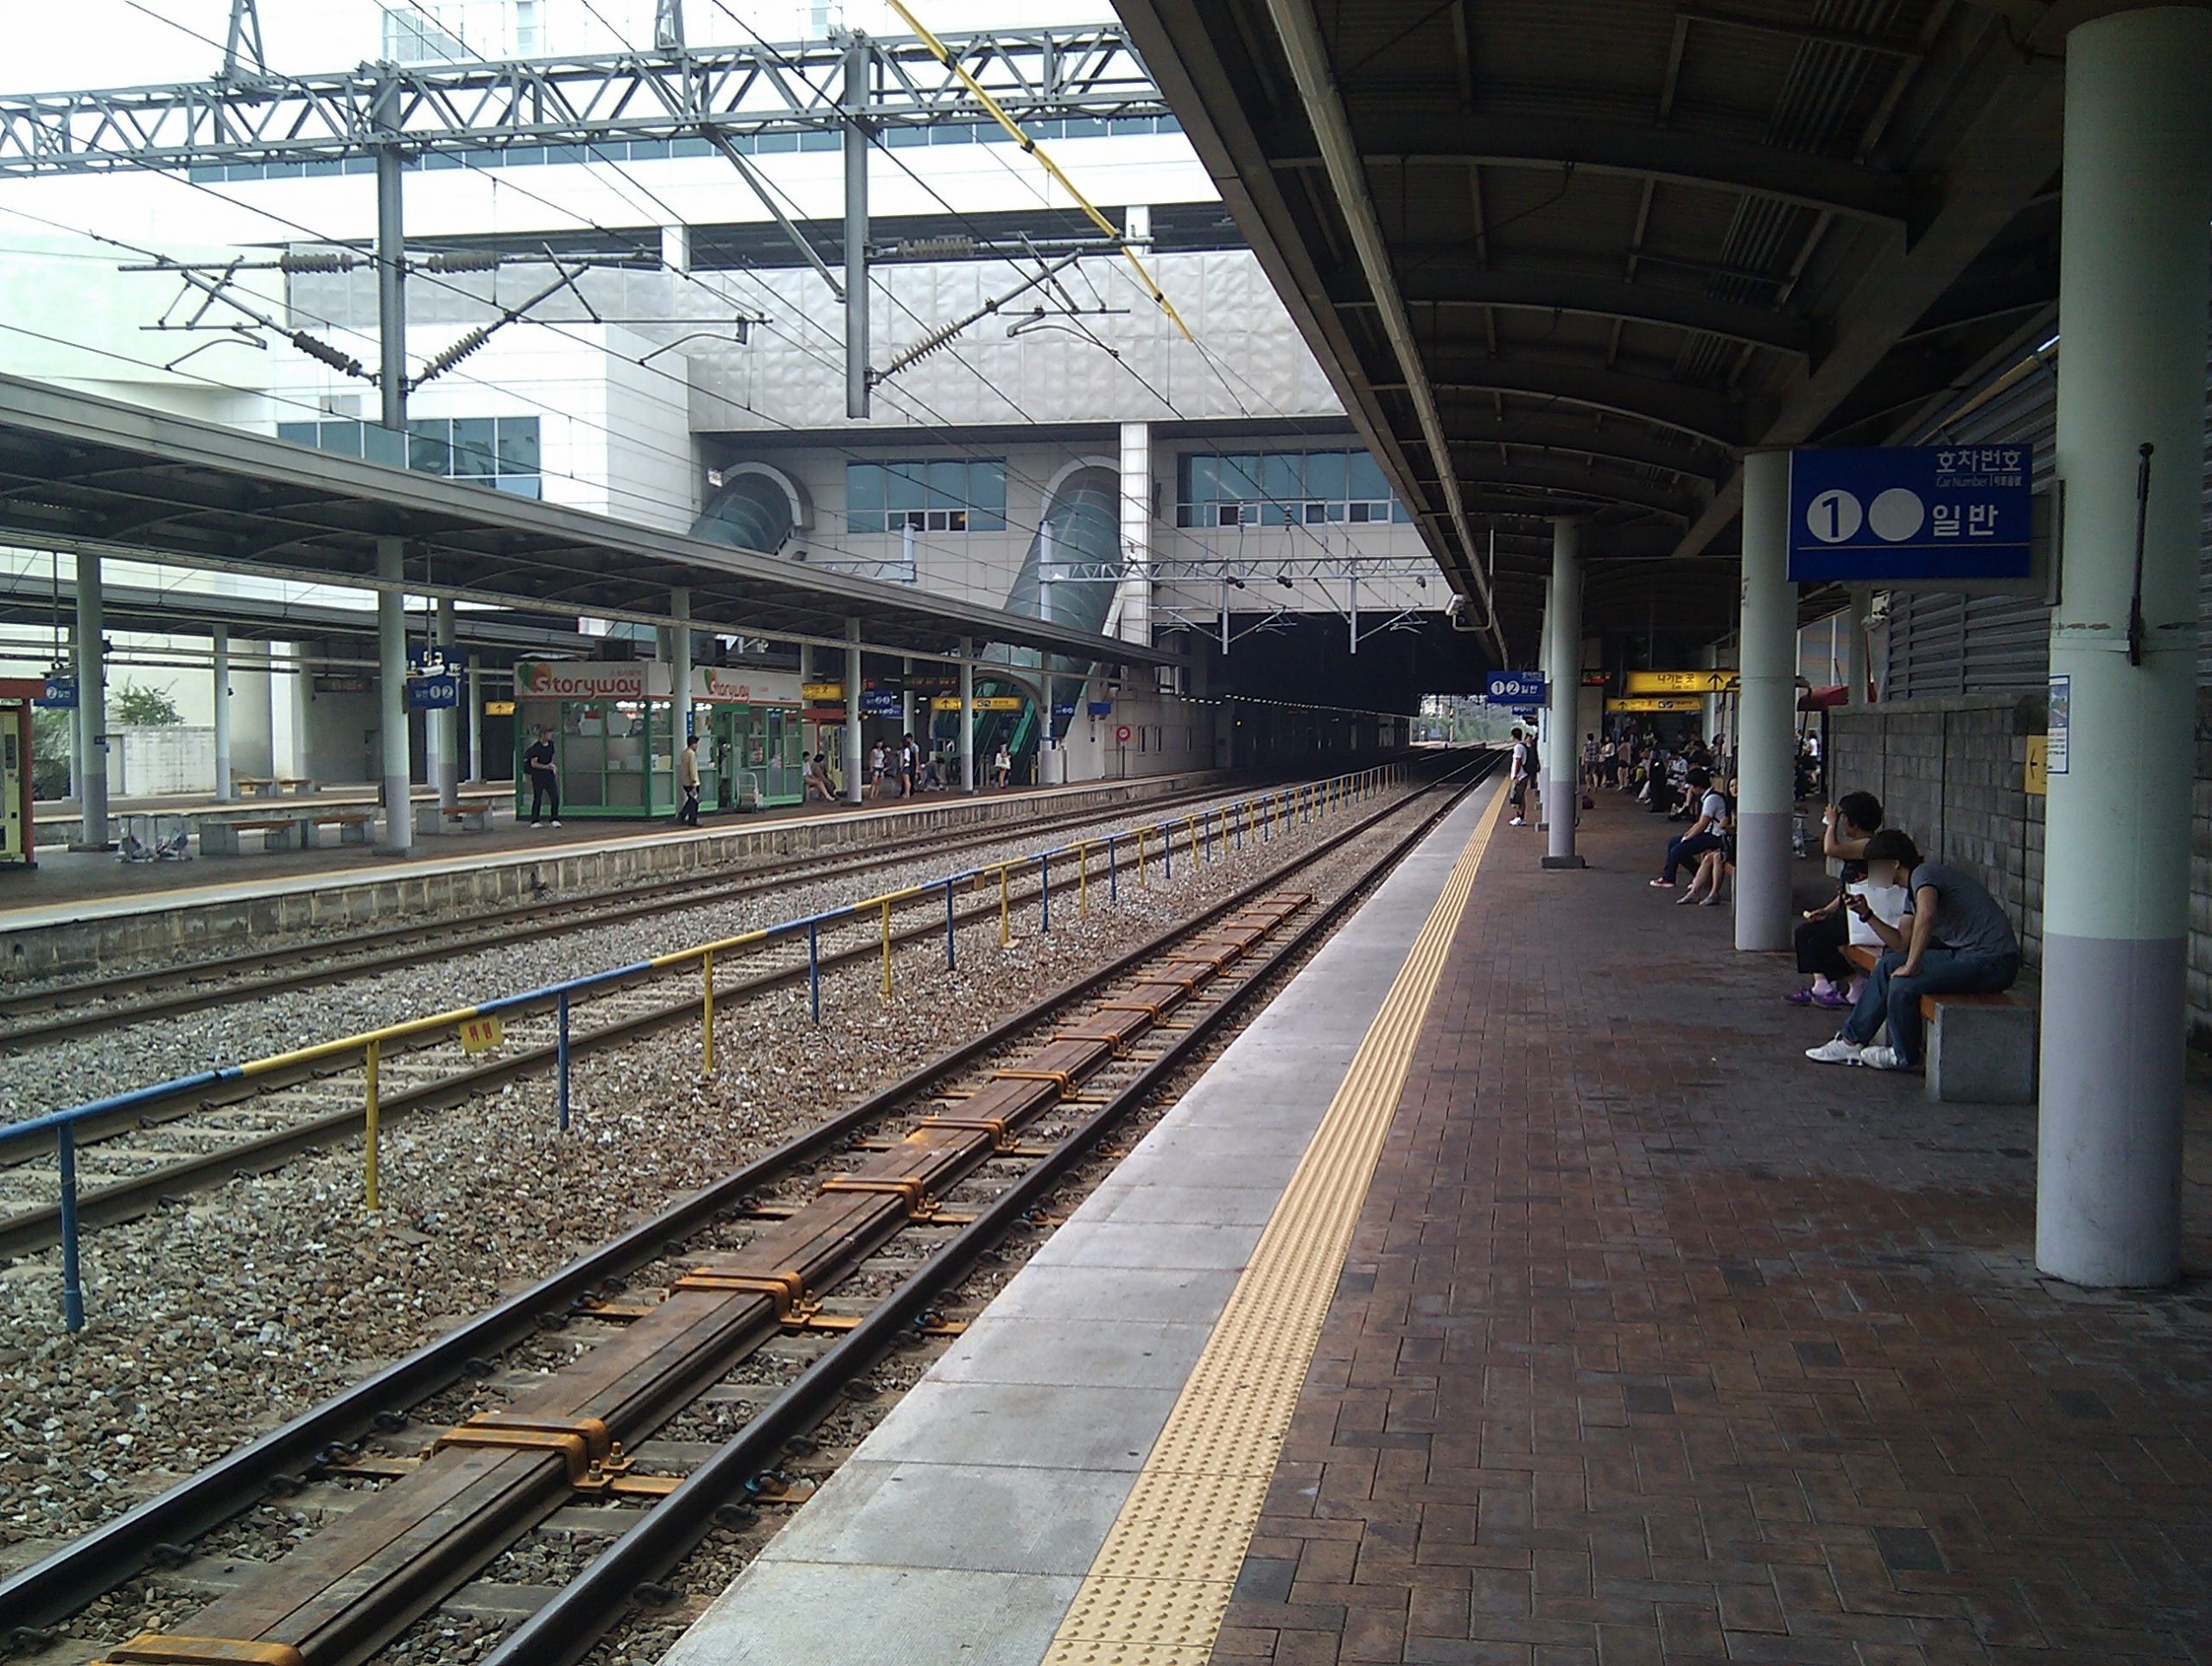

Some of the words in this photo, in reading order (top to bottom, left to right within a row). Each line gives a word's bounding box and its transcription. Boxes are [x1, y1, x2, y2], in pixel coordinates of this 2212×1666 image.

[1936, 449, 2022, 473] 호차번호
[1821, 496, 1840, 538] 1
[535, 675, 642, 698] Storyway
